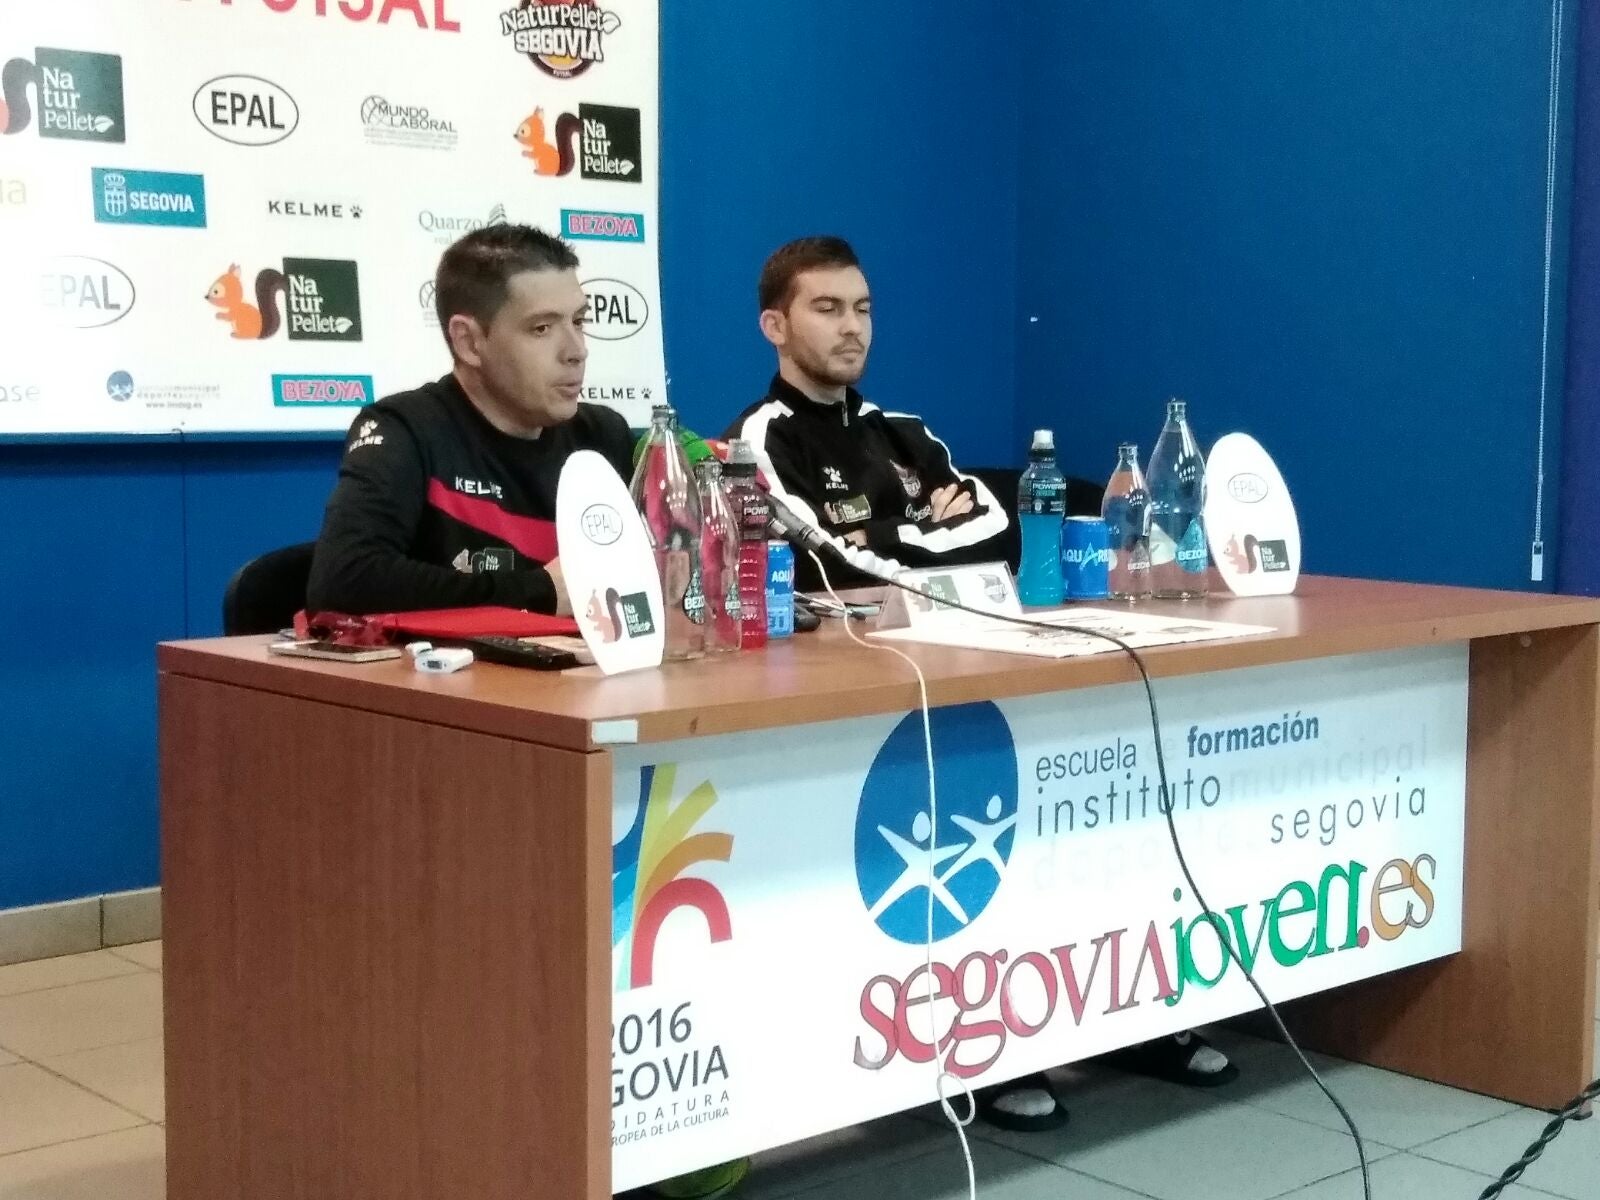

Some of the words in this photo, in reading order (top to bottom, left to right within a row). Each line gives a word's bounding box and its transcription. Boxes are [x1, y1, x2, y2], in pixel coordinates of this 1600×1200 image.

[500, 3, 604, 36] NaturPellet
[514, 27, 604, 62] SEGOVIA
[42, 66, 75, 90] Na
[43, 88, 80, 109] tur
[211, 91, 286, 129] EPAL
[44, 110, 95, 132] Pellet
[378, 104, 429, 118] MUNDO
[390, 117, 458, 133] LABORAL
[582, 118, 607, 140] Na
[582, 137, 611, 156] tur
[584, 155, 622, 175] Pellet
[129, 190, 196, 213] SEGOVIA
[268, 200, 343, 218] KELME
[418, 210, 483, 233] Quarzo
[568, 213, 639, 237] BEZOYA
[289, 275, 317, 295] Na
[290, 292, 324, 313] tur
[292, 314, 336, 334] Pellet
[280, 379, 367, 402] BEZOYA
[1035, 737, 1137, 782] escuela
[1187, 710, 1320, 758] formación
[1036, 768, 1221, 837] instituto
[1270, 776, 1426, 846] segovia
[612, 1001, 692, 1058] 016
[650, 1123, 664, 1137] DE
[667, 1119, 680, 1133] LA
[683, 1106, 730, 1128] CULTURA
